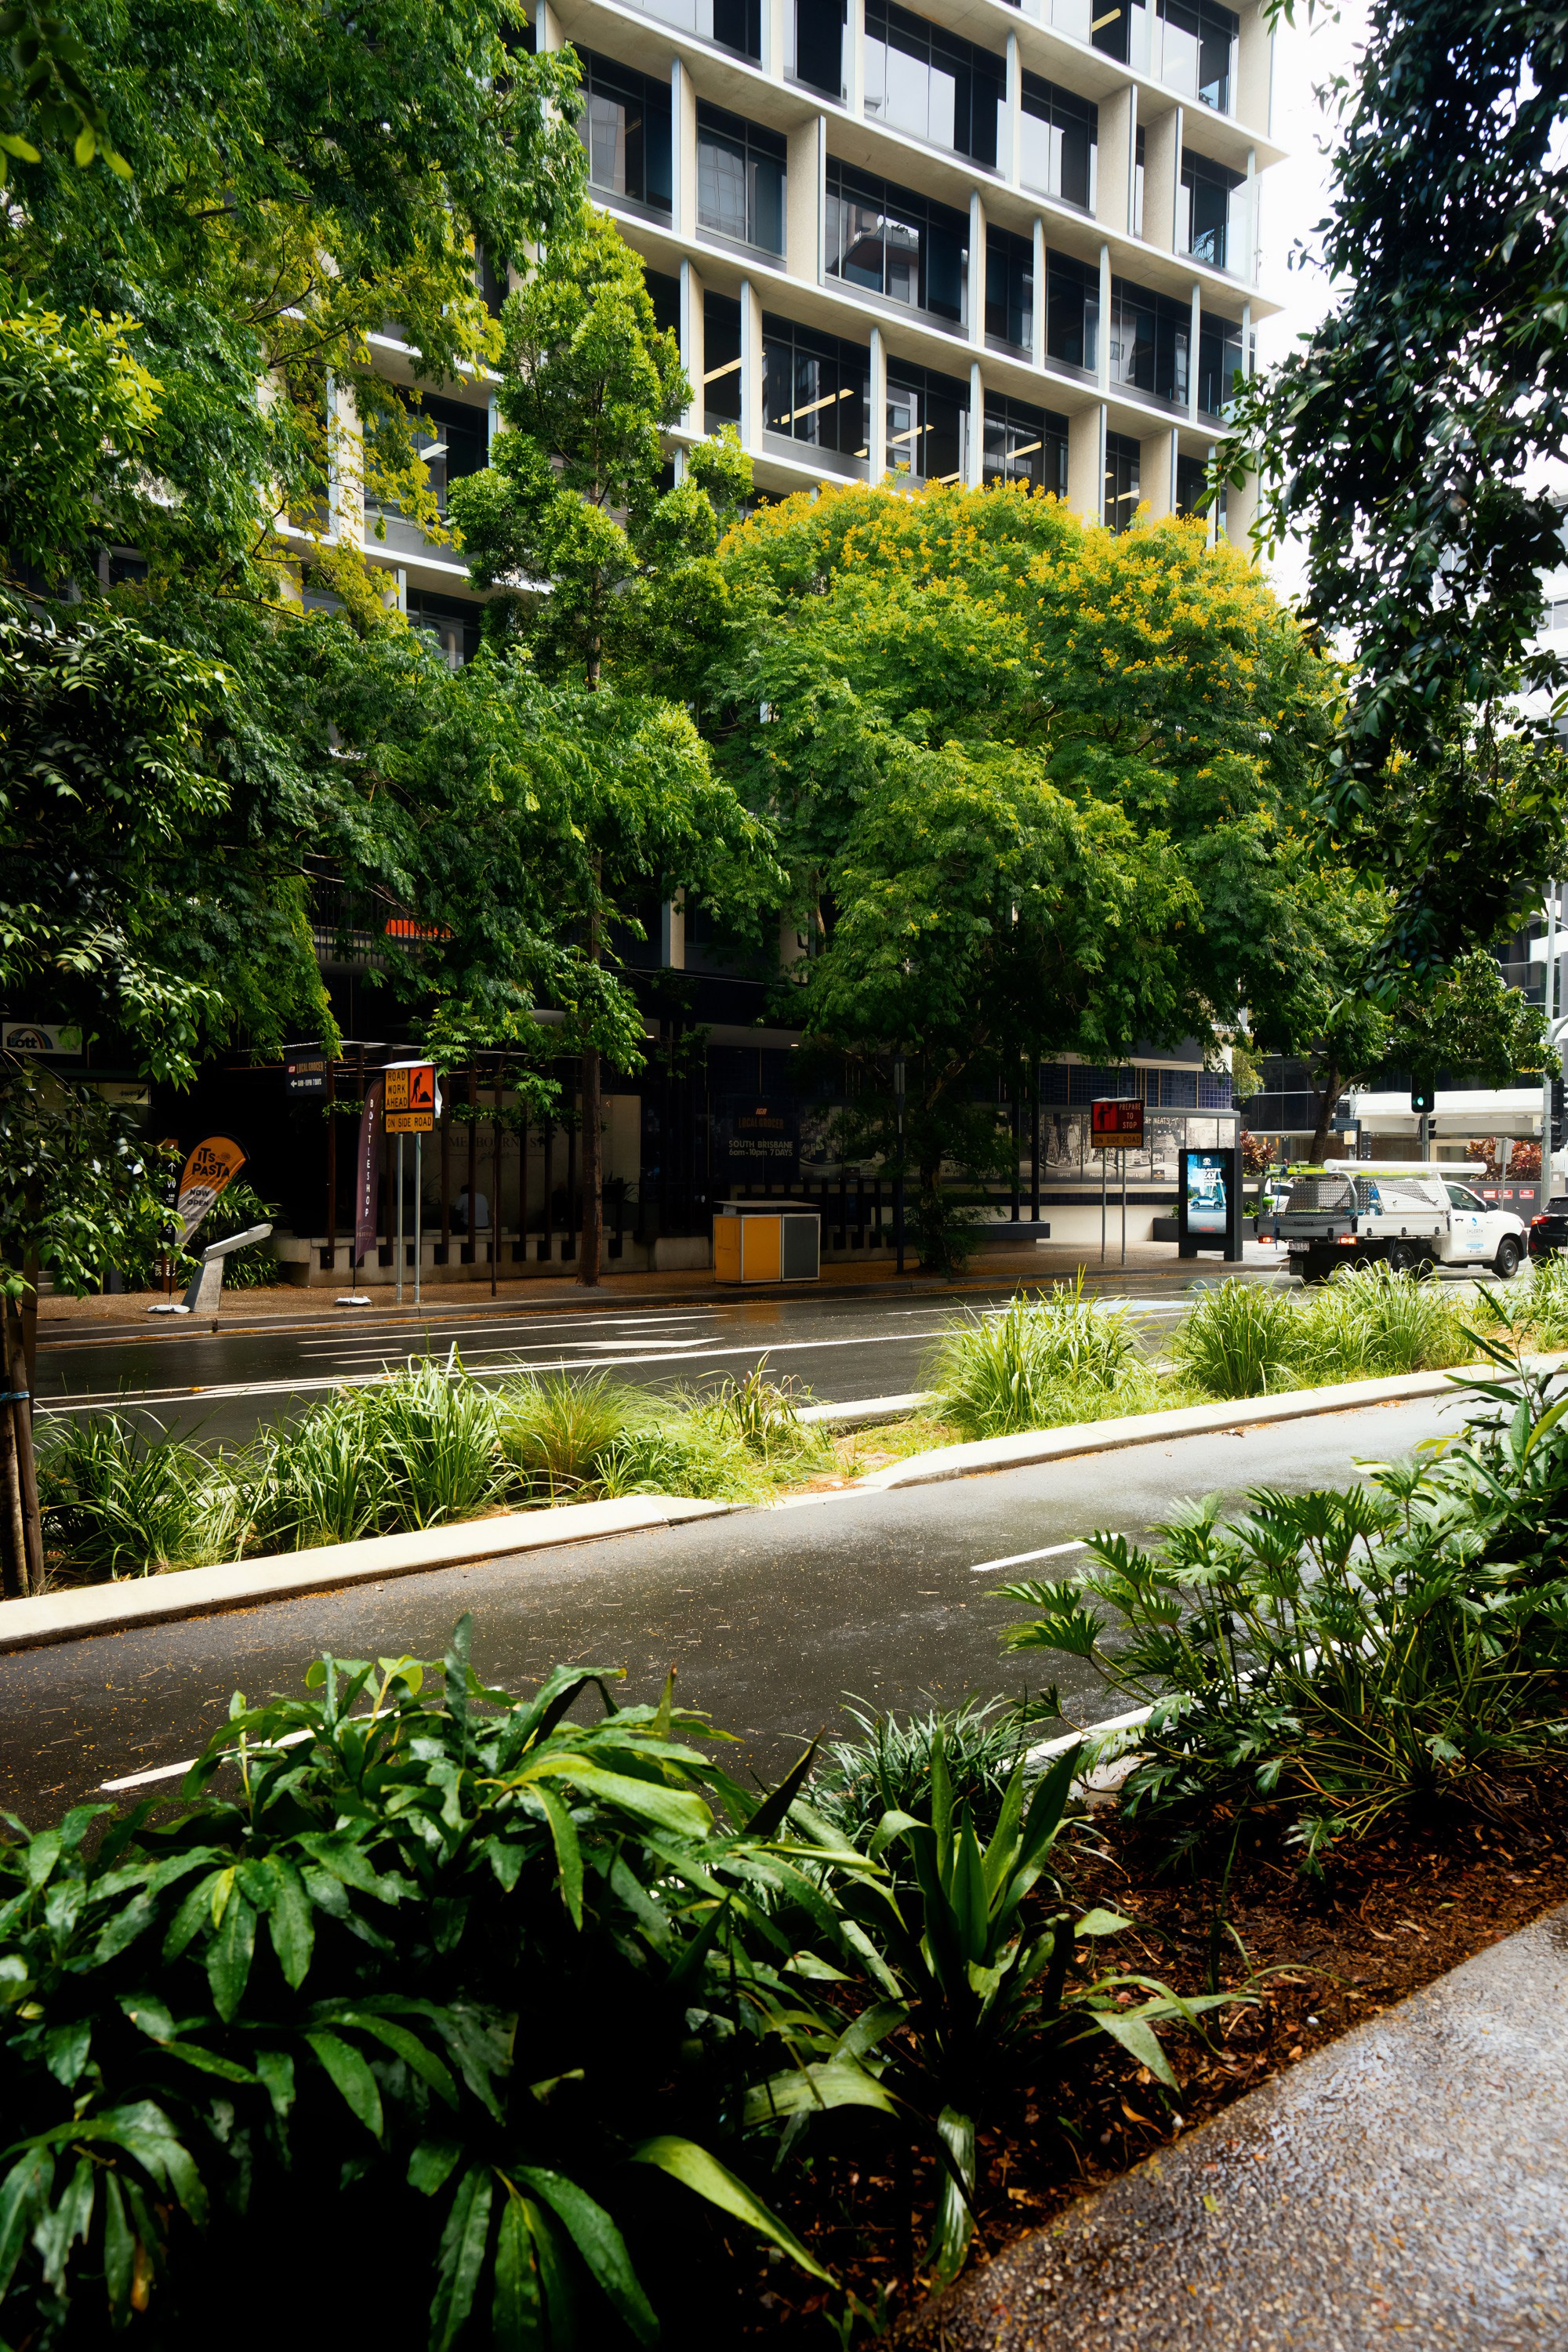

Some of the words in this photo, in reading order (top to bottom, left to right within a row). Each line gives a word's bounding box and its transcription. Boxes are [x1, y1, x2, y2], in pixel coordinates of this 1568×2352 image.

[7, 1036, 38, 1048] Lott
[388, 1071, 405, 1082] ROAD
[388, 1084, 405, 1094] WORK
[387, 1098, 408, 1108] AHEAD
[387, 1119, 395, 1127] ON
[398, 1117, 412, 1127] SIDE
[415, 1116, 432, 1127] ROAD
[728, 1140, 755, 1149] SOUTH
[198, 1147, 216, 1163] ITS
[365, 1098, 374, 1218] BOTTLESHOP
[191, 1162, 230, 1178] PASTA
